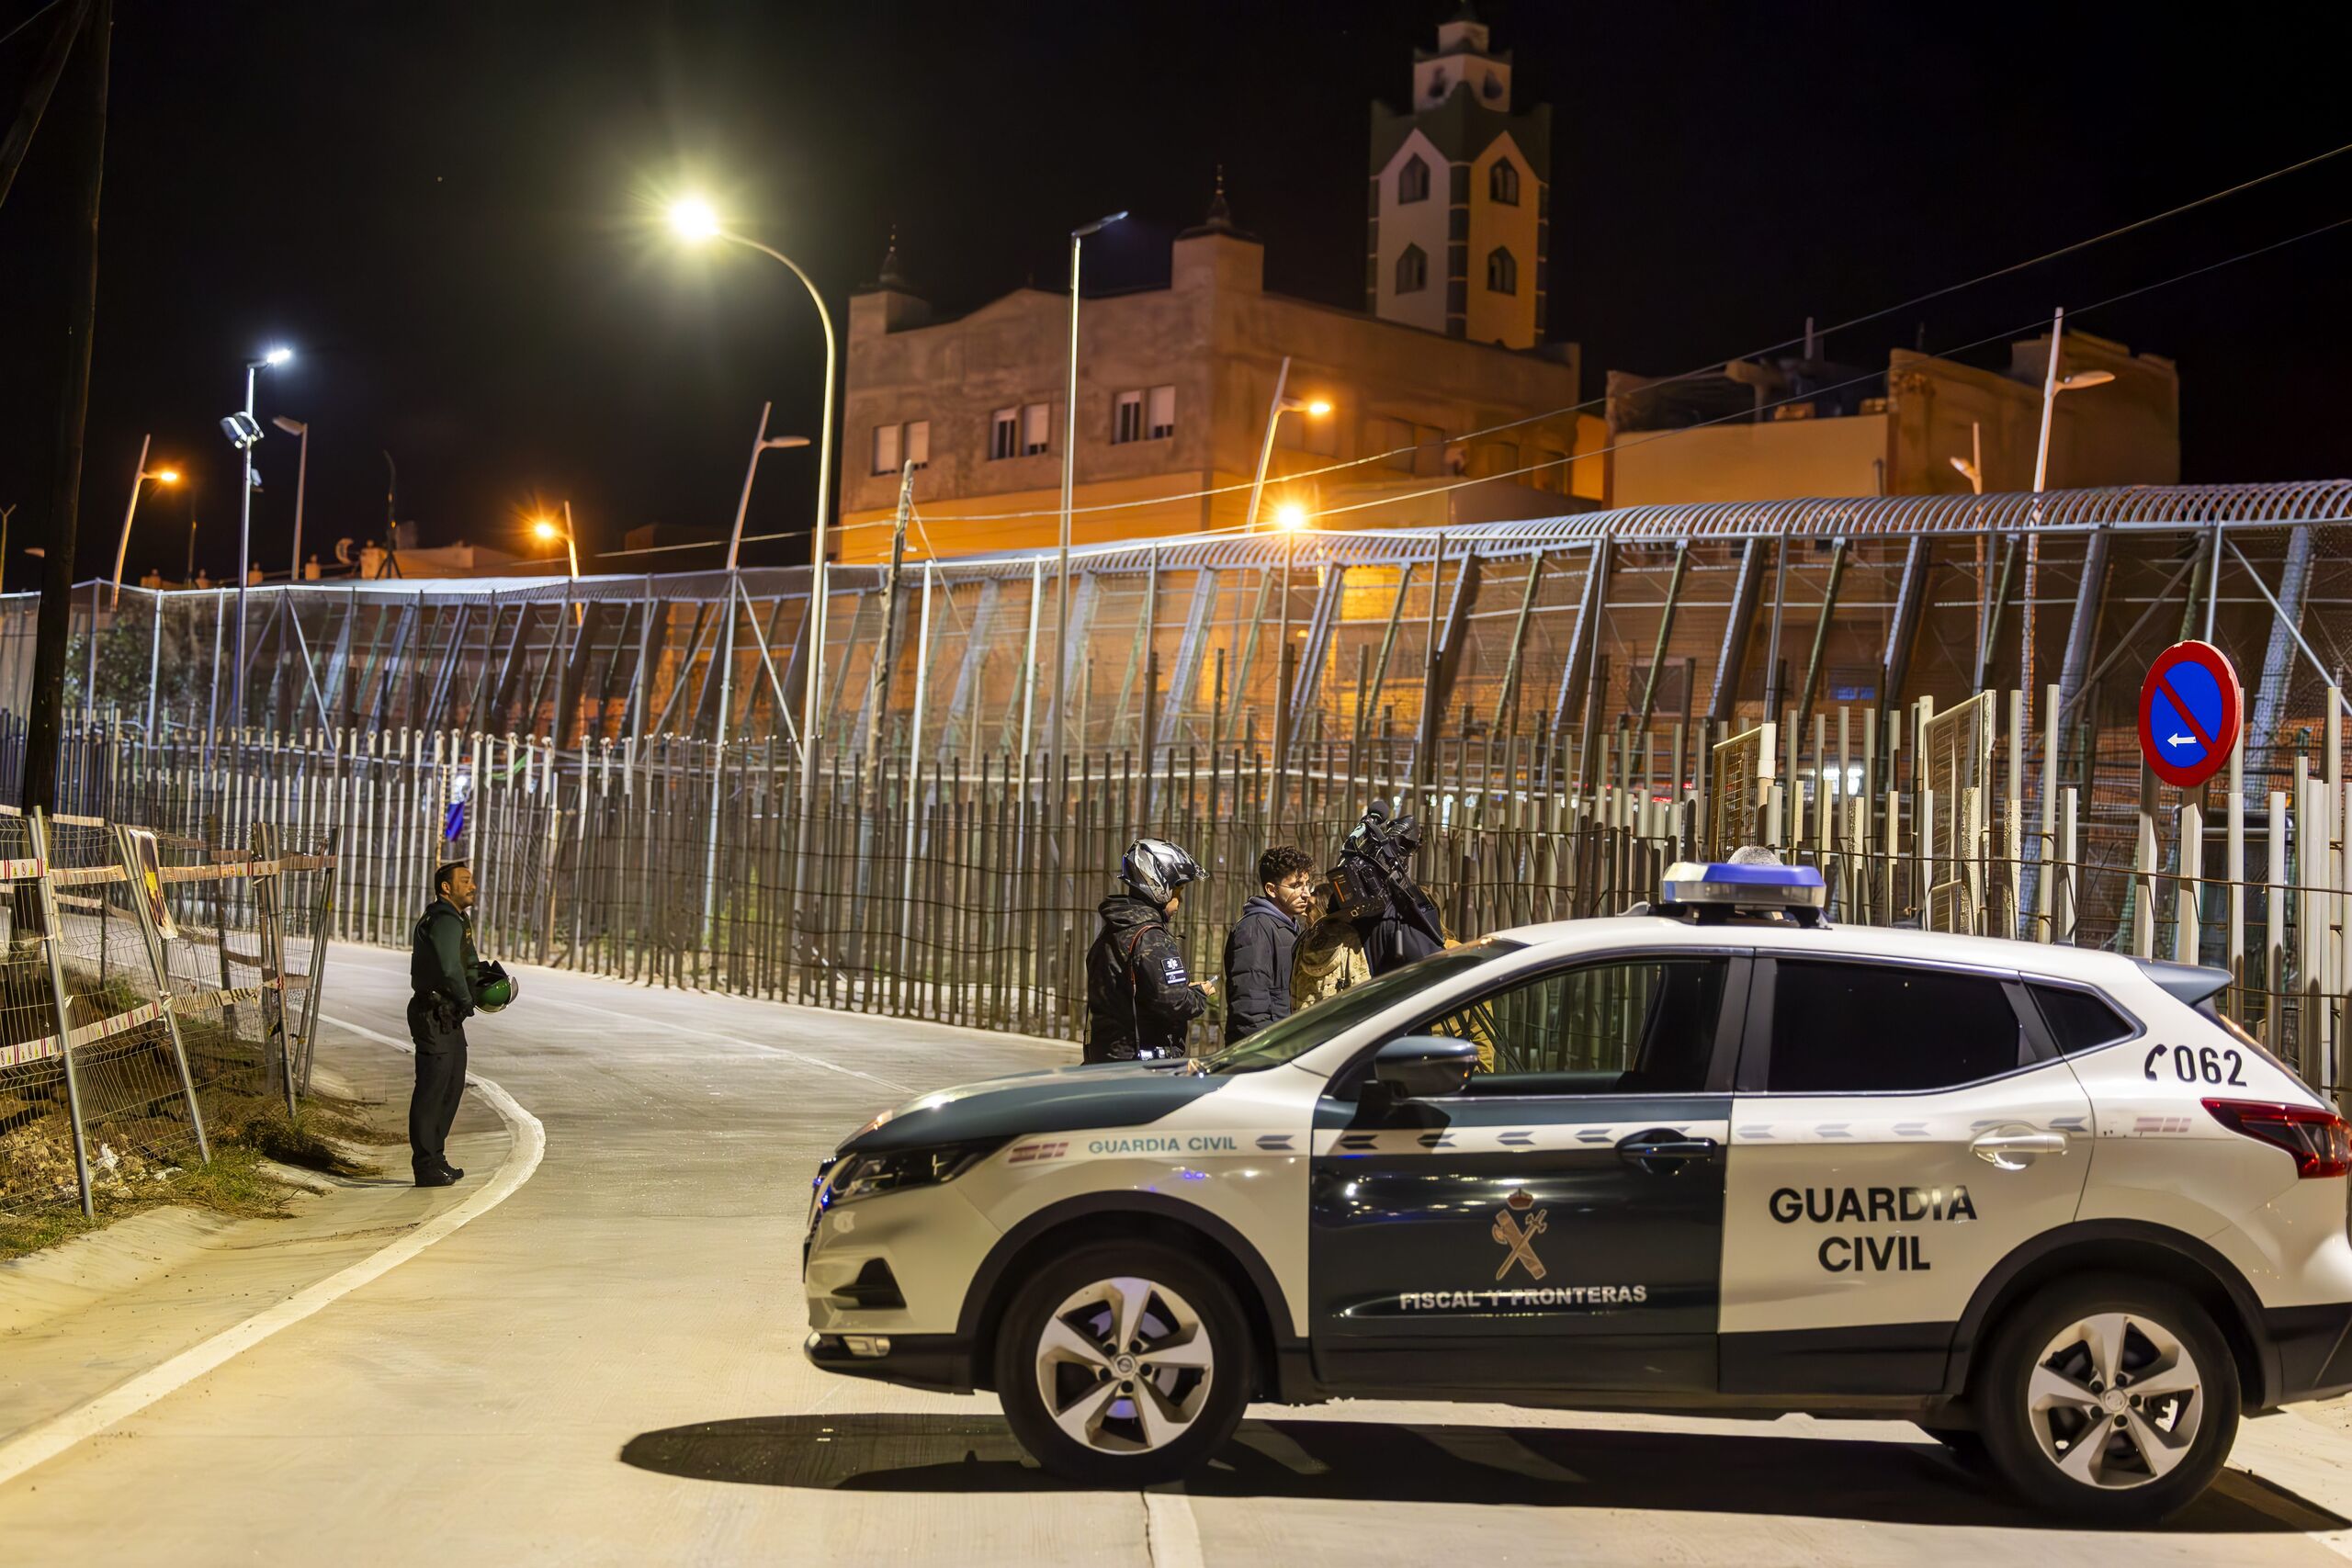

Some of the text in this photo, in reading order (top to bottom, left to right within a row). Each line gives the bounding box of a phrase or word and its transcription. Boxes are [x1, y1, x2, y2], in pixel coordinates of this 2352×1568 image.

[2174, 1045, 2247, 1087] 062
[1089, 1136, 1238, 1154] GUARDIA CIVIL
[1769, 1185, 1977, 1224] GUARDIA
[1818, 1236, 1930, 1272] CIVIL
[1400, 1285, 1647, 1310] FISCAL Y FRONTERAS
